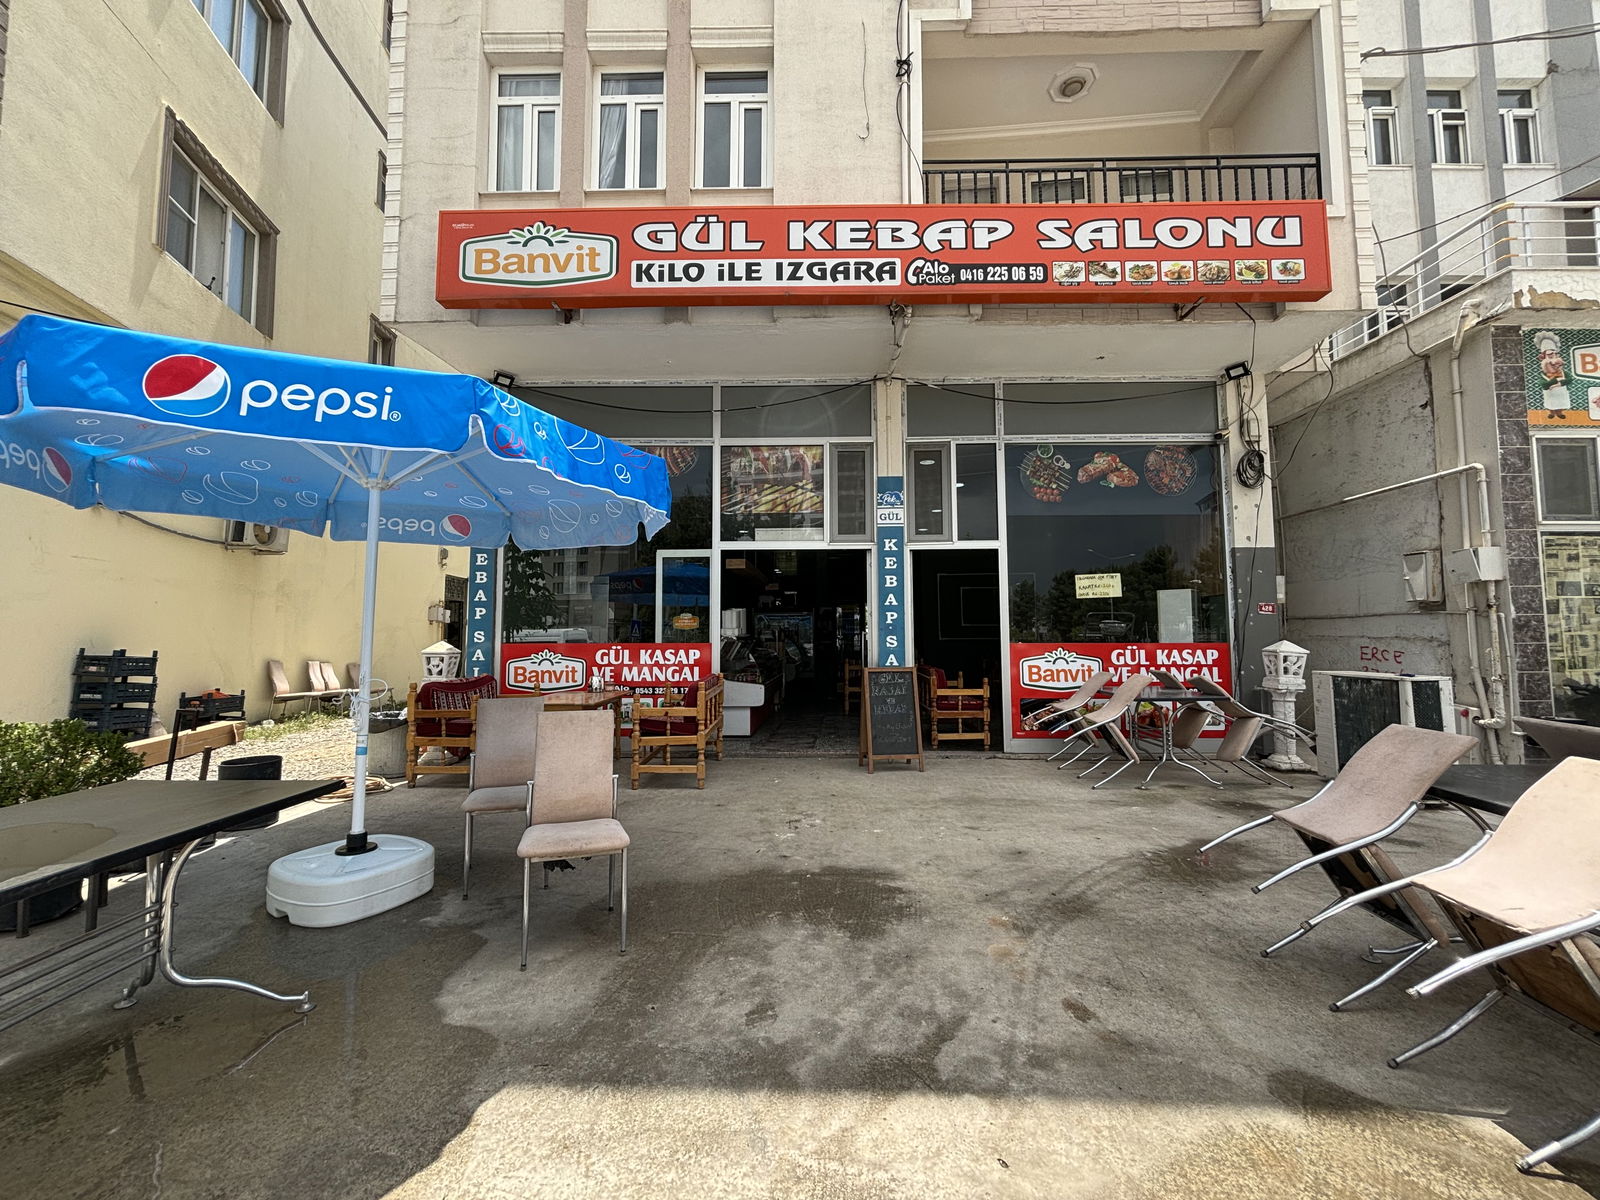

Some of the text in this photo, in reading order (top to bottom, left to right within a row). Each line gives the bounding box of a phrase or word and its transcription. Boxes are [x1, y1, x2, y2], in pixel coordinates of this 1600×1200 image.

[632, 215, 1303, 253] GÜL KEBAP SALONU
[474, 245, 600, 275] Banvit
[923, 262, 949, 274] Alo
[776, 261, 897, 283] IZGARA
[919, 273, 955, 284] Paket
[960, 267, 1044, 281] 0416 225 06 59
[1580, 353, 1600, 373] B
[239, 379, 392, 422] pepsi
[879, 511, 902, 521] GÜL
[884, 539, 898, 624] KEBAP
[595, 645, 701, 665] GÜL KASAP
[1111, 645, 1219, 665] GÜL KASAP
[1360, 646, 1405, 664] ERCE
[513, 664, 578, 684] Banvit
[1027, 663, 1095, 683] Banvit
